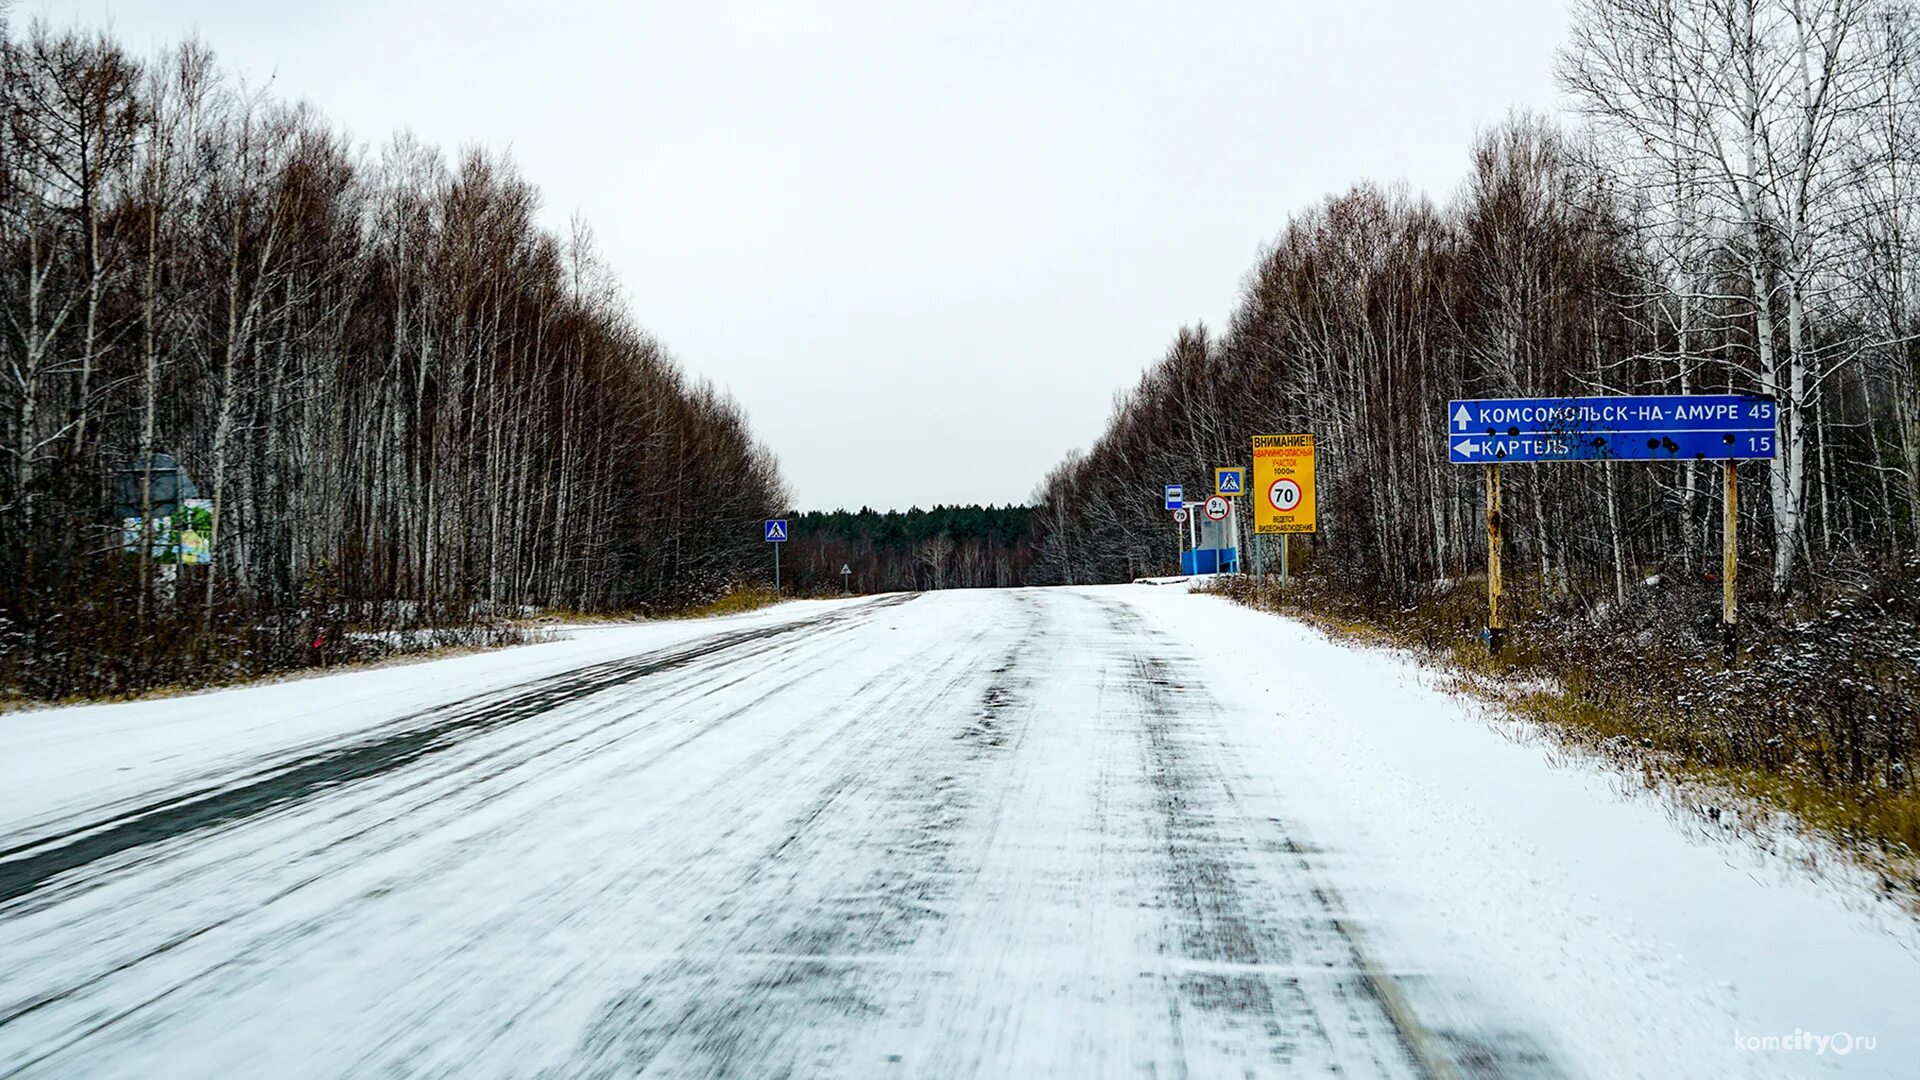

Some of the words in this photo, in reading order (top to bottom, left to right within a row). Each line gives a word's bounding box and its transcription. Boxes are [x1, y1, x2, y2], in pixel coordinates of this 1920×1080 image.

[1479, 404, 1739, 424] КОМСОМОЛЬСК-НА-АМУРЕ
[1748, 404, 1771, 419] 45
[1481, 440, 1569, 456] КАРТЕЛЬ
[1274, 488, 1294, 503] 70
